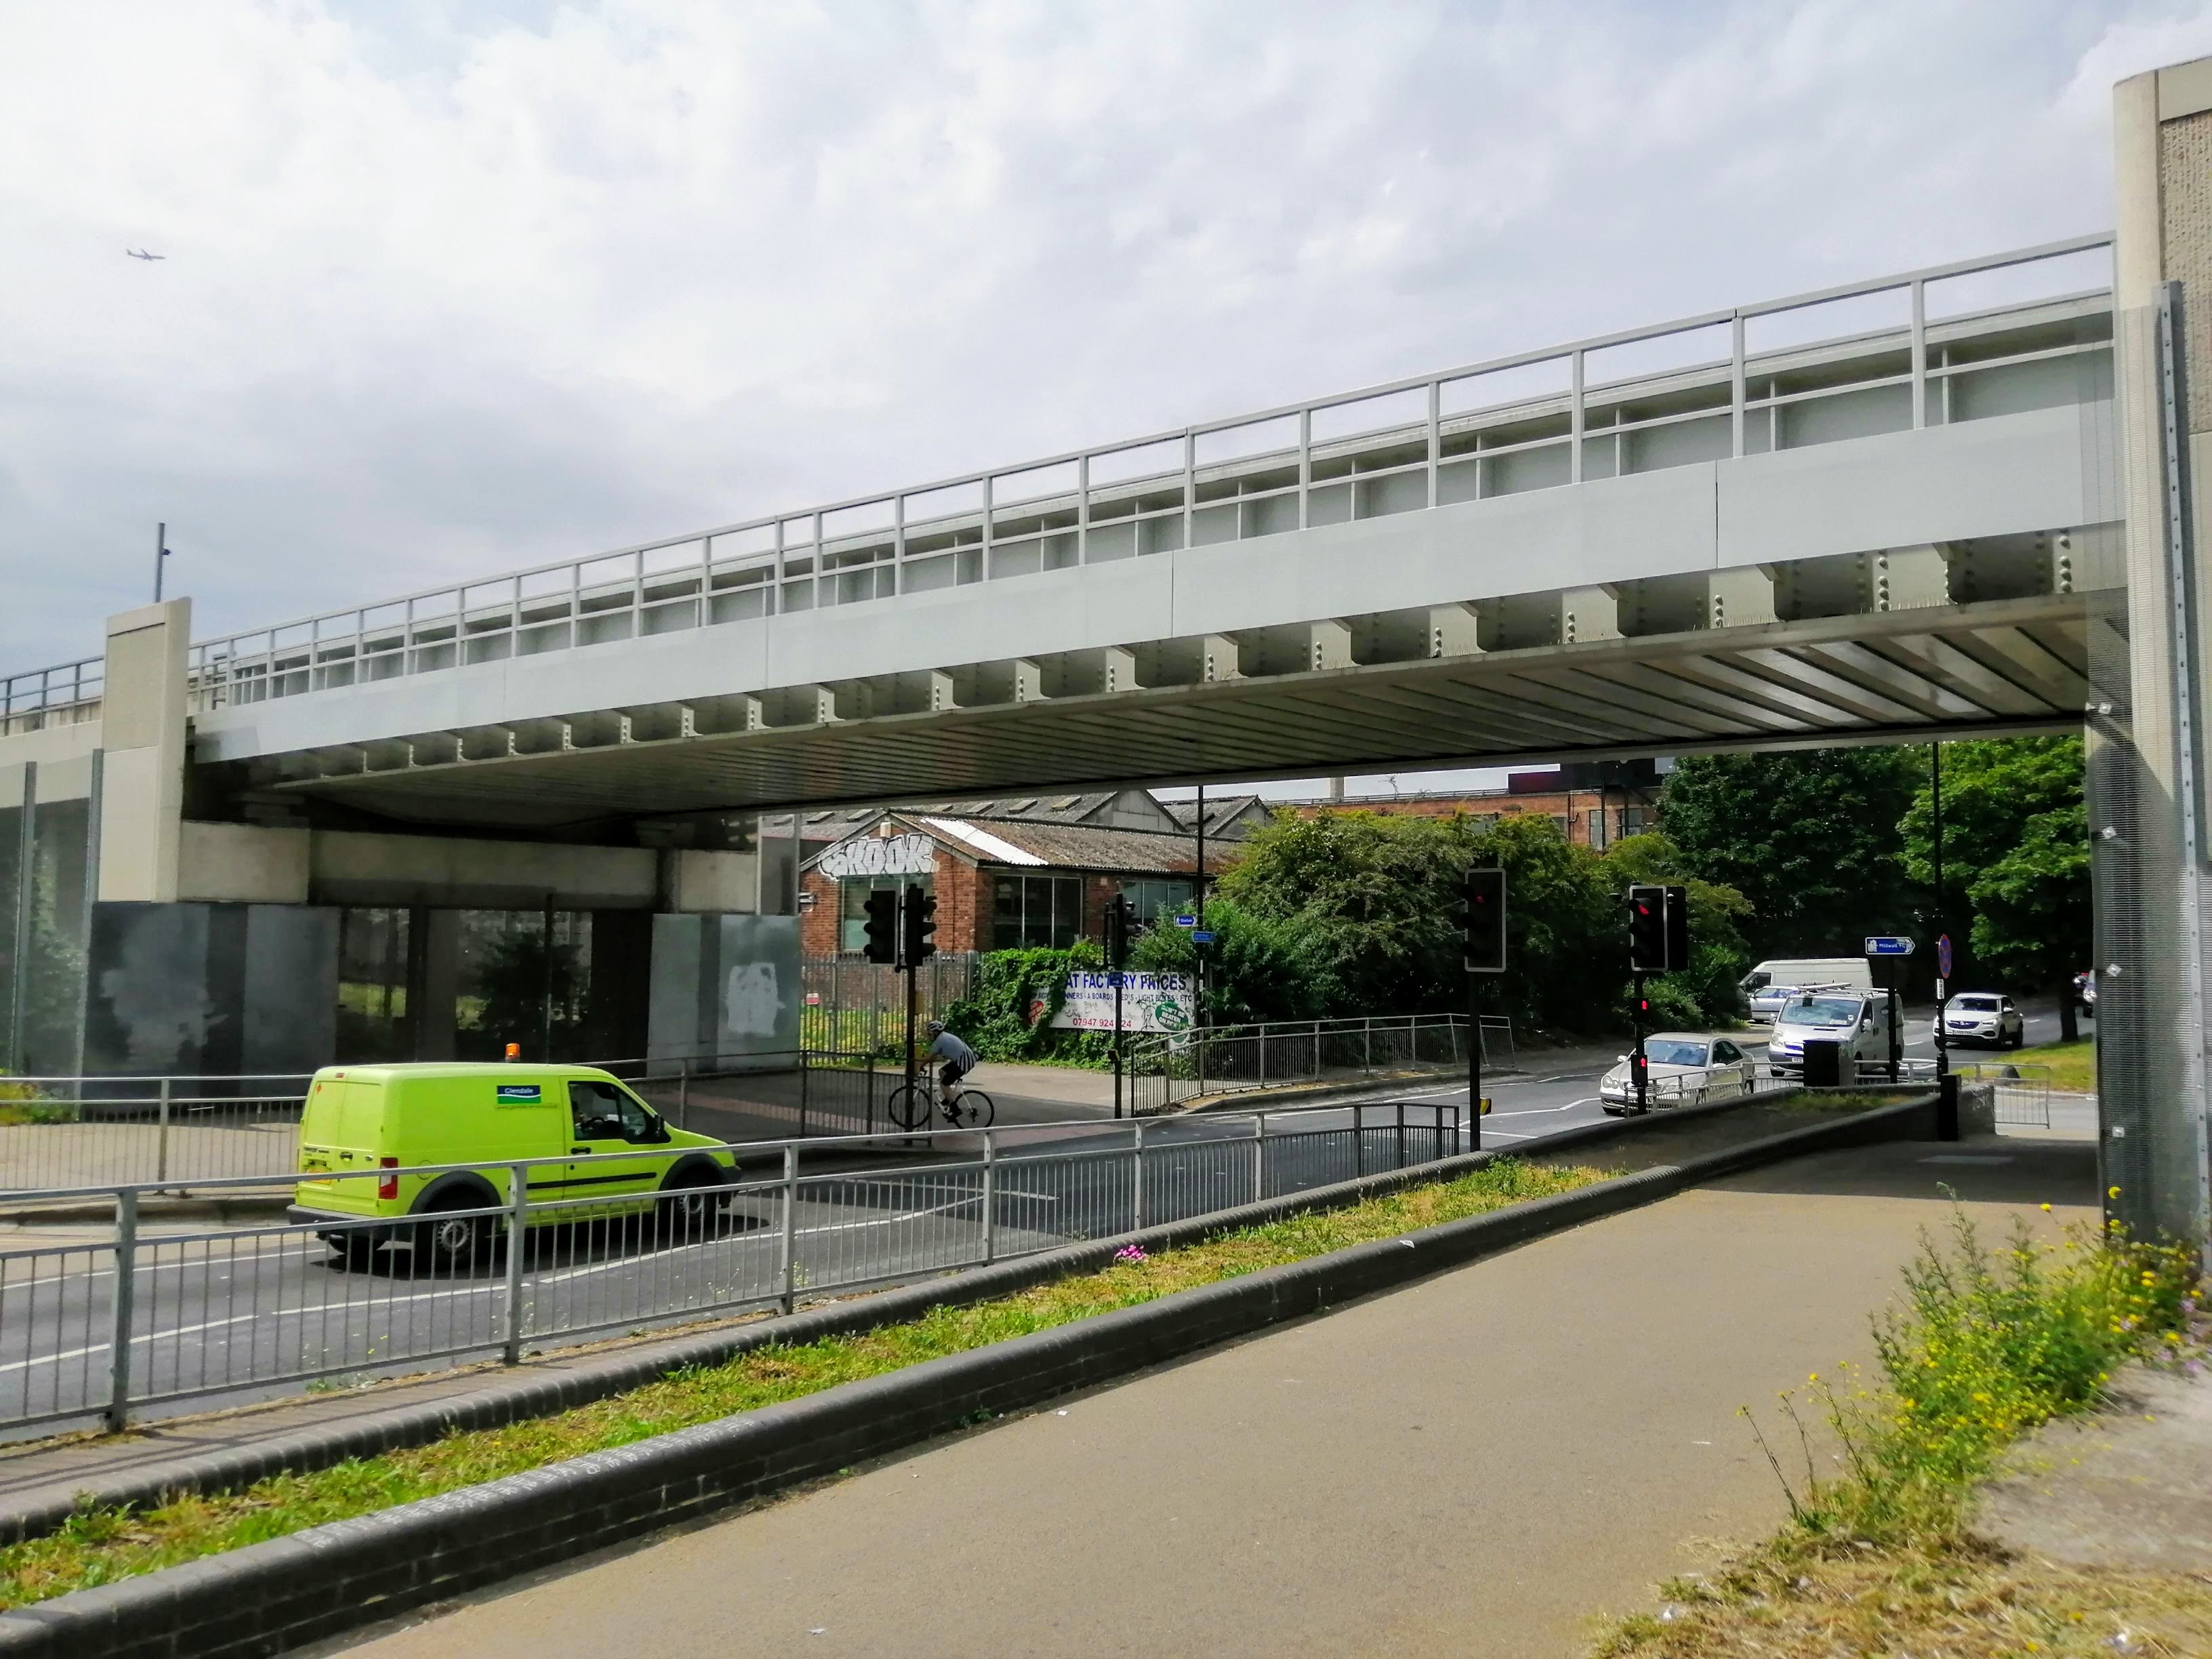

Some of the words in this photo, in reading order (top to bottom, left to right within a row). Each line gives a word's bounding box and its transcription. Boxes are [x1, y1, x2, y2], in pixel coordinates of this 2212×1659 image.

[1065, 973, 1080, 988] AT
[1083, 973, 1136, 989] FACTRY
[1140, 975, 1187, 990] PRICES
[1180, 995, 1192, 1003] ETC
[1073, 1018, 1097, 1026] 07947
[1099, 1019, 1114, 1027] 924
